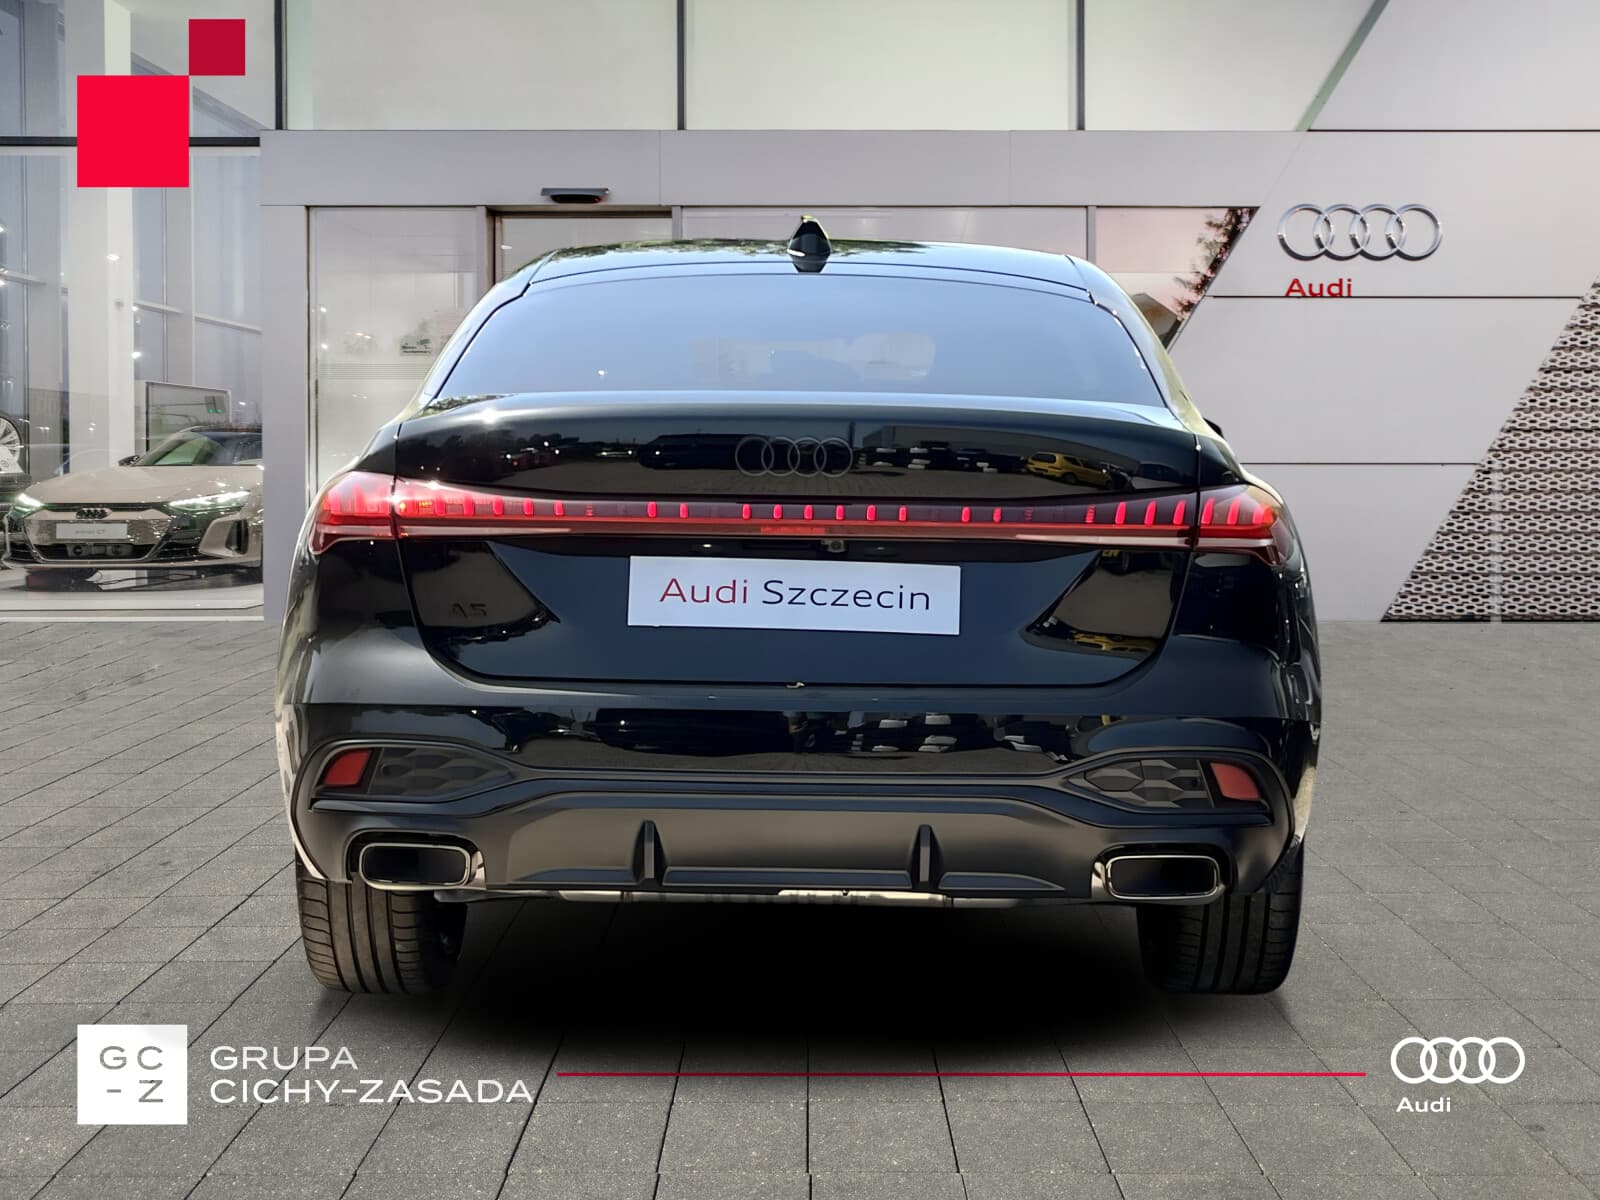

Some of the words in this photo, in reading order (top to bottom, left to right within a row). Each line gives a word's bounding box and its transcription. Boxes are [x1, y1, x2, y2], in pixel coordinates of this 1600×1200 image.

[1285, 278, 1352, 298] Audi
[660, 578, 749, 606] Audi
[761, 579, 931, 611] Szczecin
